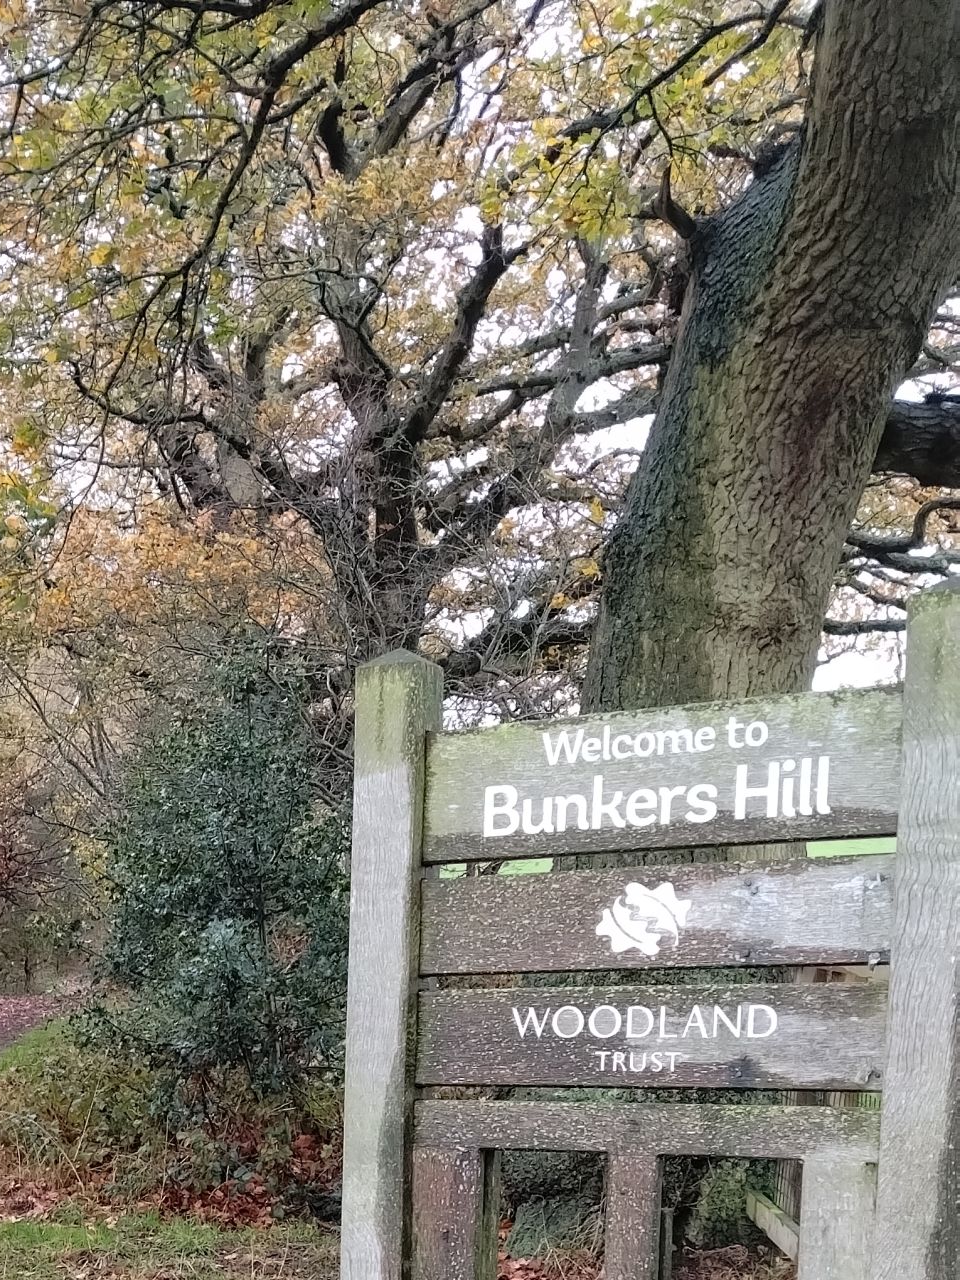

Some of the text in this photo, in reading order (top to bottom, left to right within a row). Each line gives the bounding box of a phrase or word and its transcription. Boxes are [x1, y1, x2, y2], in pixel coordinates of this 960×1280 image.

[543, 717, 769, 766] Welcome to
[483, 756, 831, 838] Bunkers Hill
[512, 1004, 778, 1039] WOODLAND
[595, 1051, 682, 1073] TRUST
